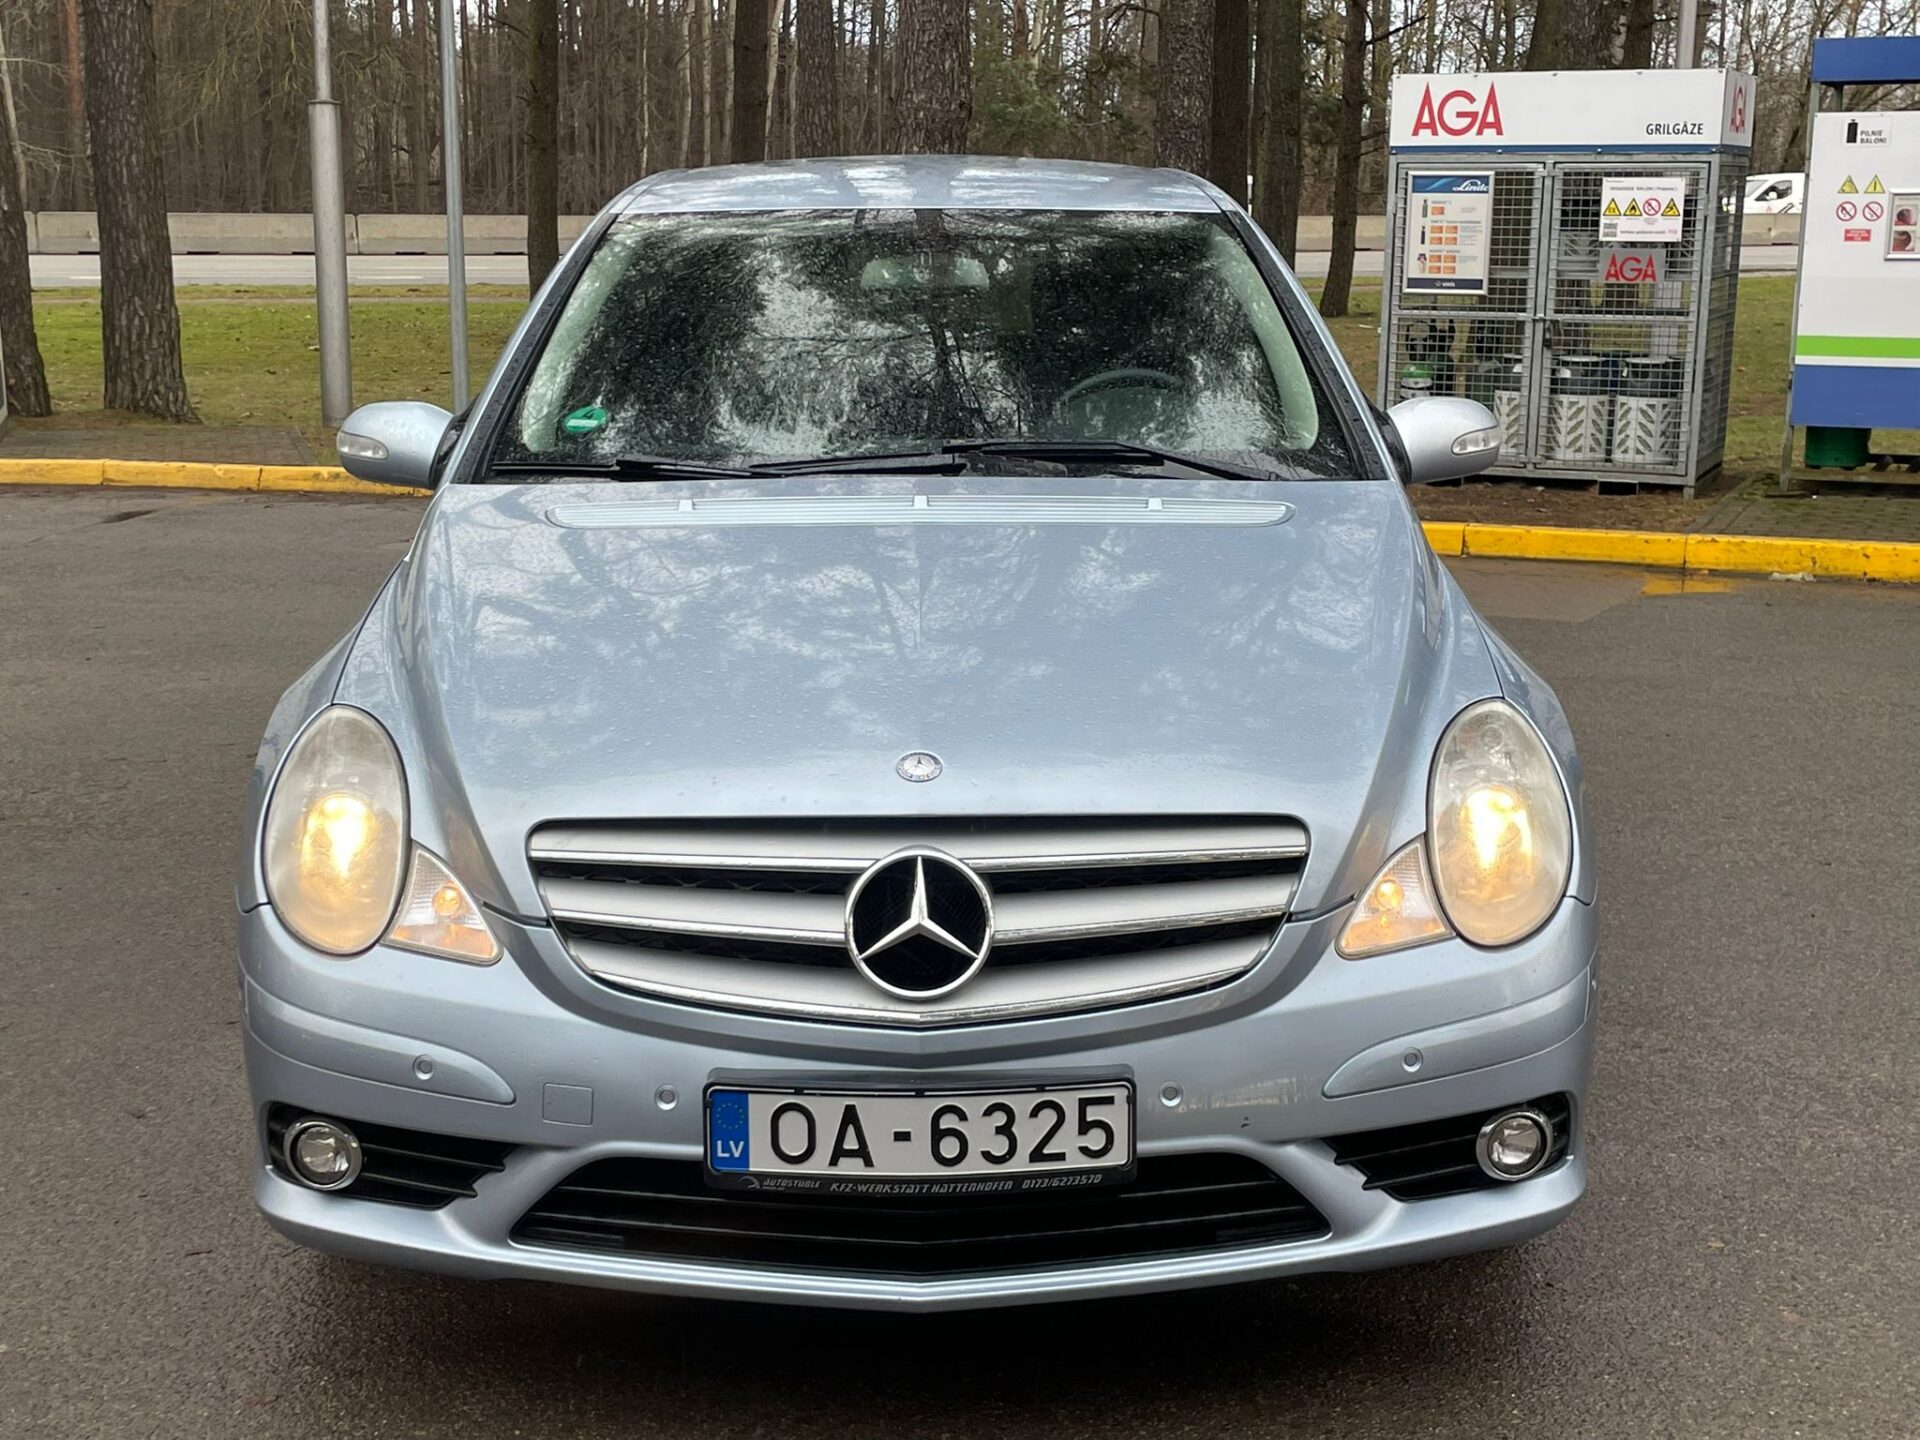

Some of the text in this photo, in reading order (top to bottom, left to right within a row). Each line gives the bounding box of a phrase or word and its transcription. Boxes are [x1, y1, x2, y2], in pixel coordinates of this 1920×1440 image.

[1411, 81, 1504, 137] AGA
[1645, 121, 1704, 136] GRILGĀZE
[1452, 179, 1489, 192] Linde
[1605, 252, 1657, 282] AGA
[769, 1094, 1116, 1168] OA-6325
[716, 1140, 744, 1158] LV
[829, 1182, 930, 1193] KFZ-WERKSTATT
[931, 1180, 1014, 1193] HATTENHOFEN
